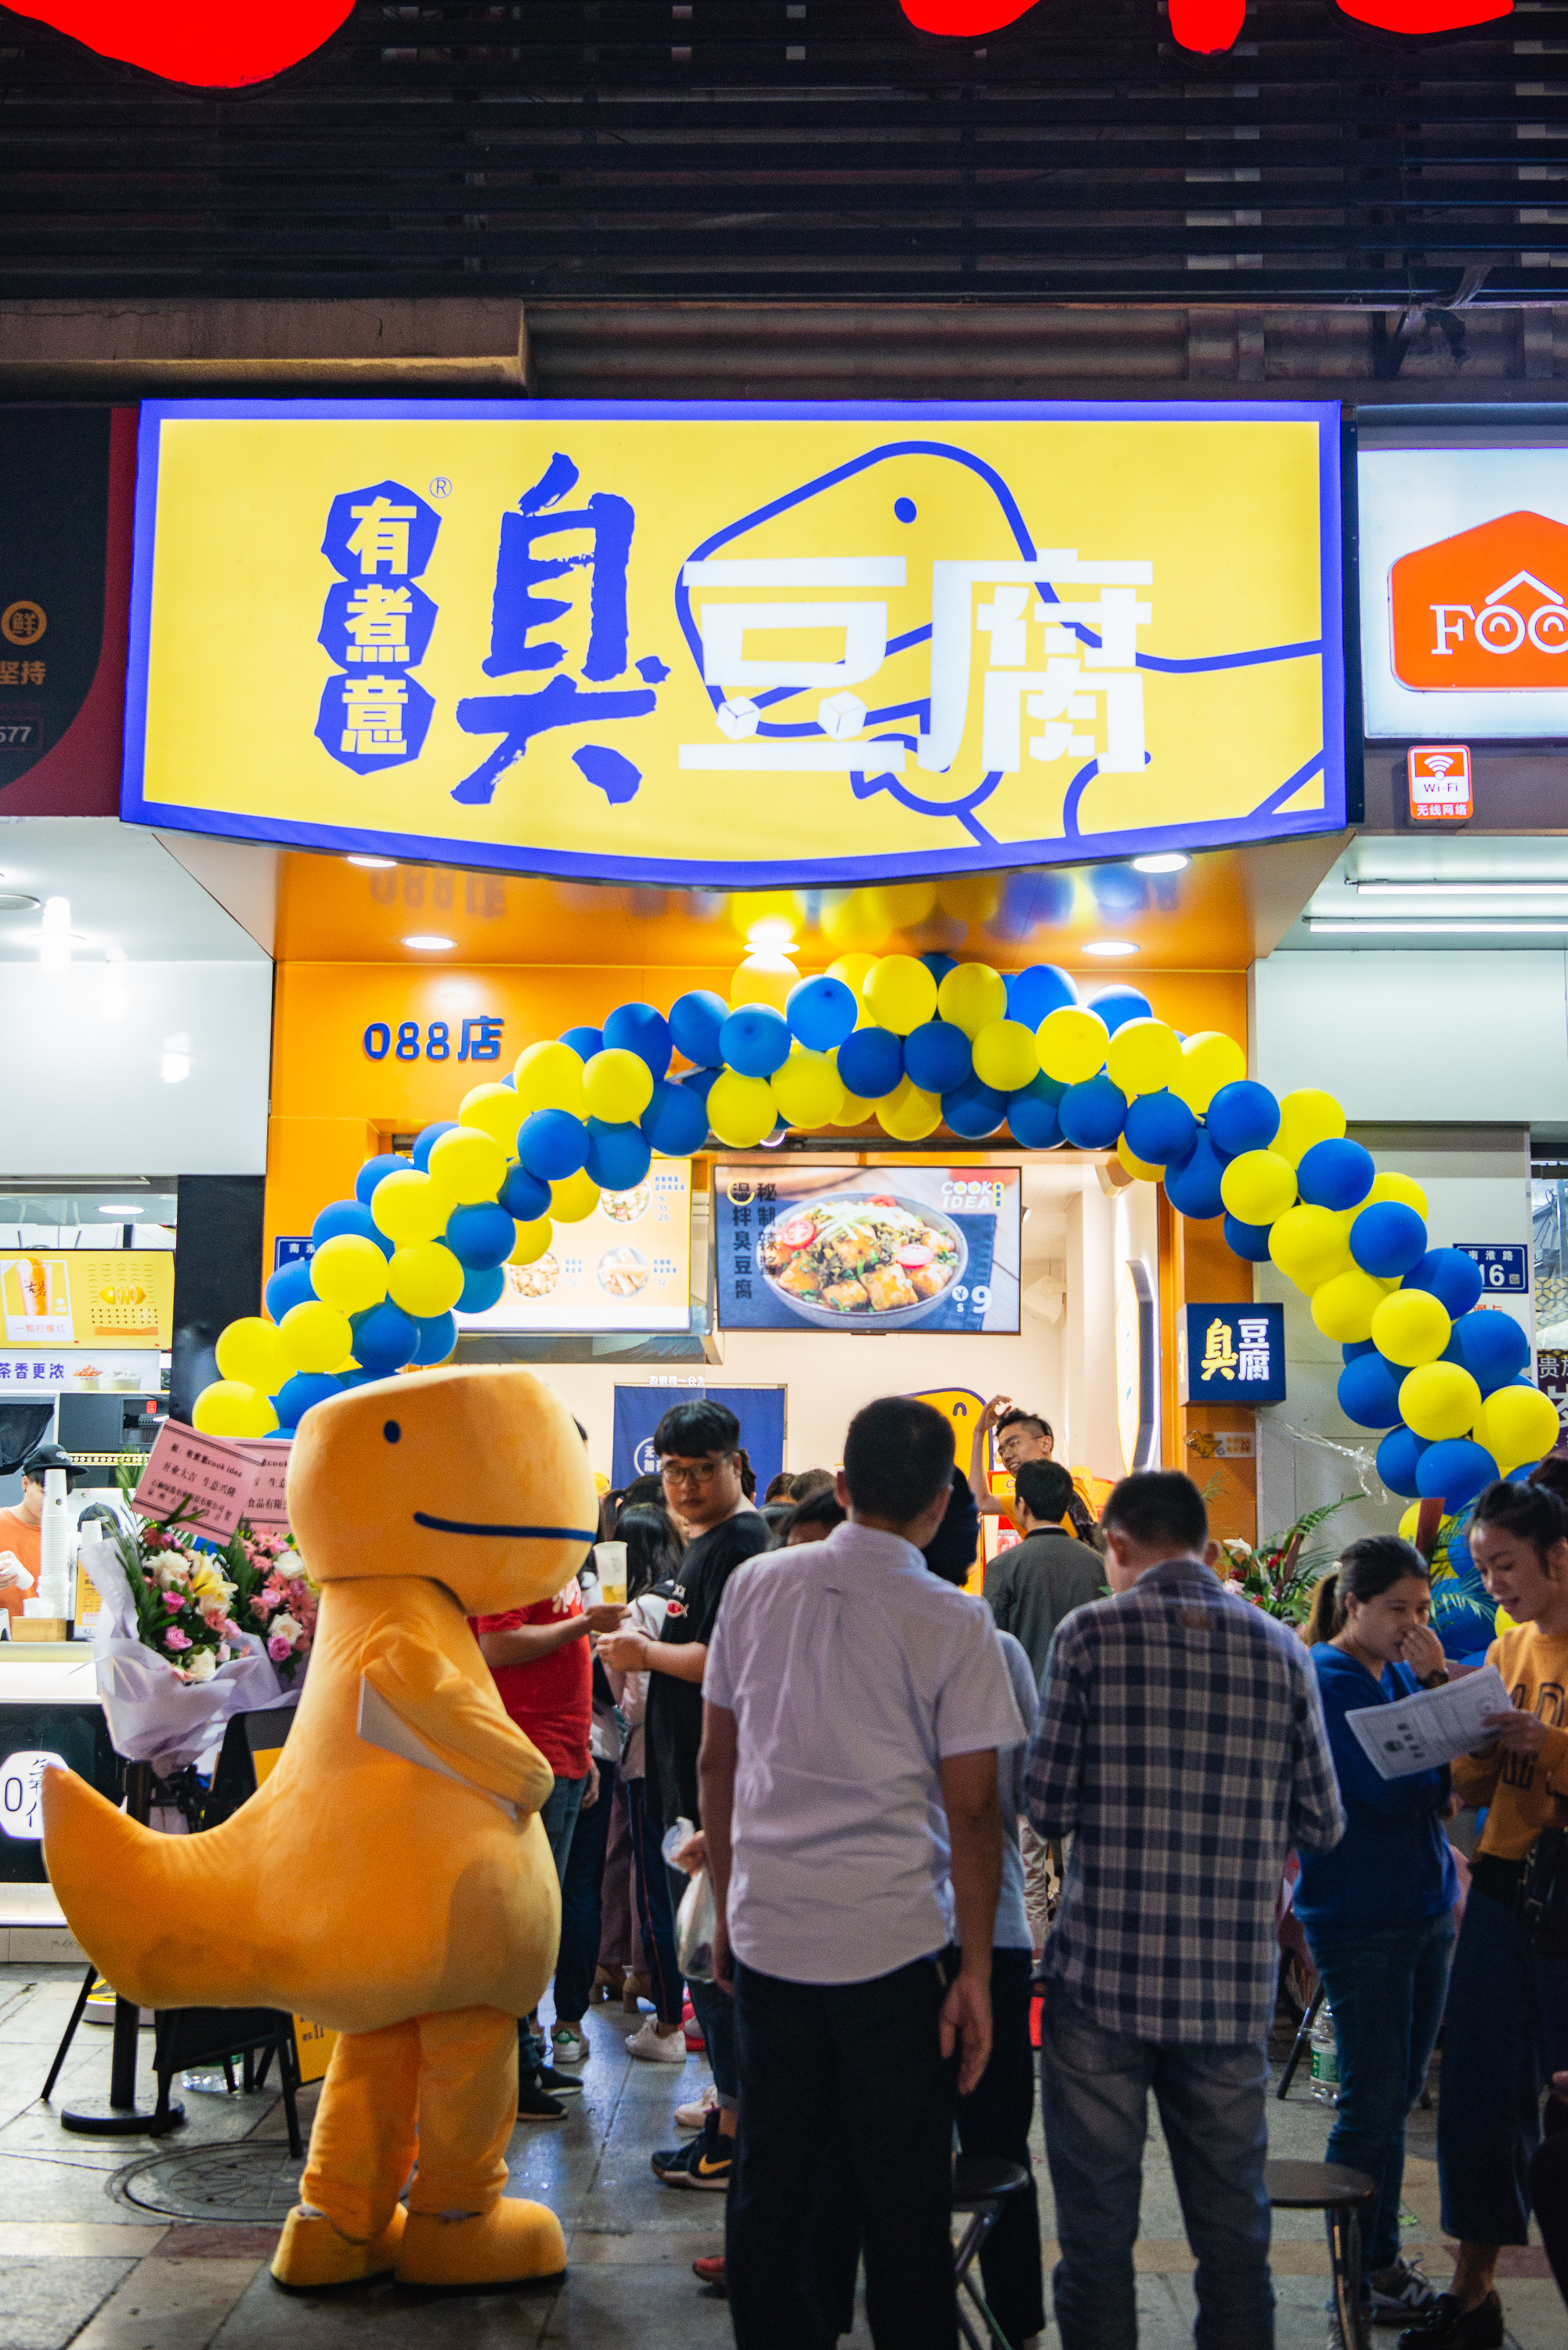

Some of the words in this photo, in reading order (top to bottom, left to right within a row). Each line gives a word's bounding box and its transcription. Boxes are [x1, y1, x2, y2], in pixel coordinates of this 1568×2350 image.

[340, 496, 417, 756] 有煮意
[450, 453, 1154, 804] 臭豆腐
[1424, 783, 1458, 793] Wi-Fi
[1416, 804, 1468, 816] 无线网络
[363, 1015, 504, 1061] 088店
[941, 1180, 993, 1195] COOK
[941, 1196, 991, 1209] IDEA
[0, 1363, 64, 1379] 茶香更浓
